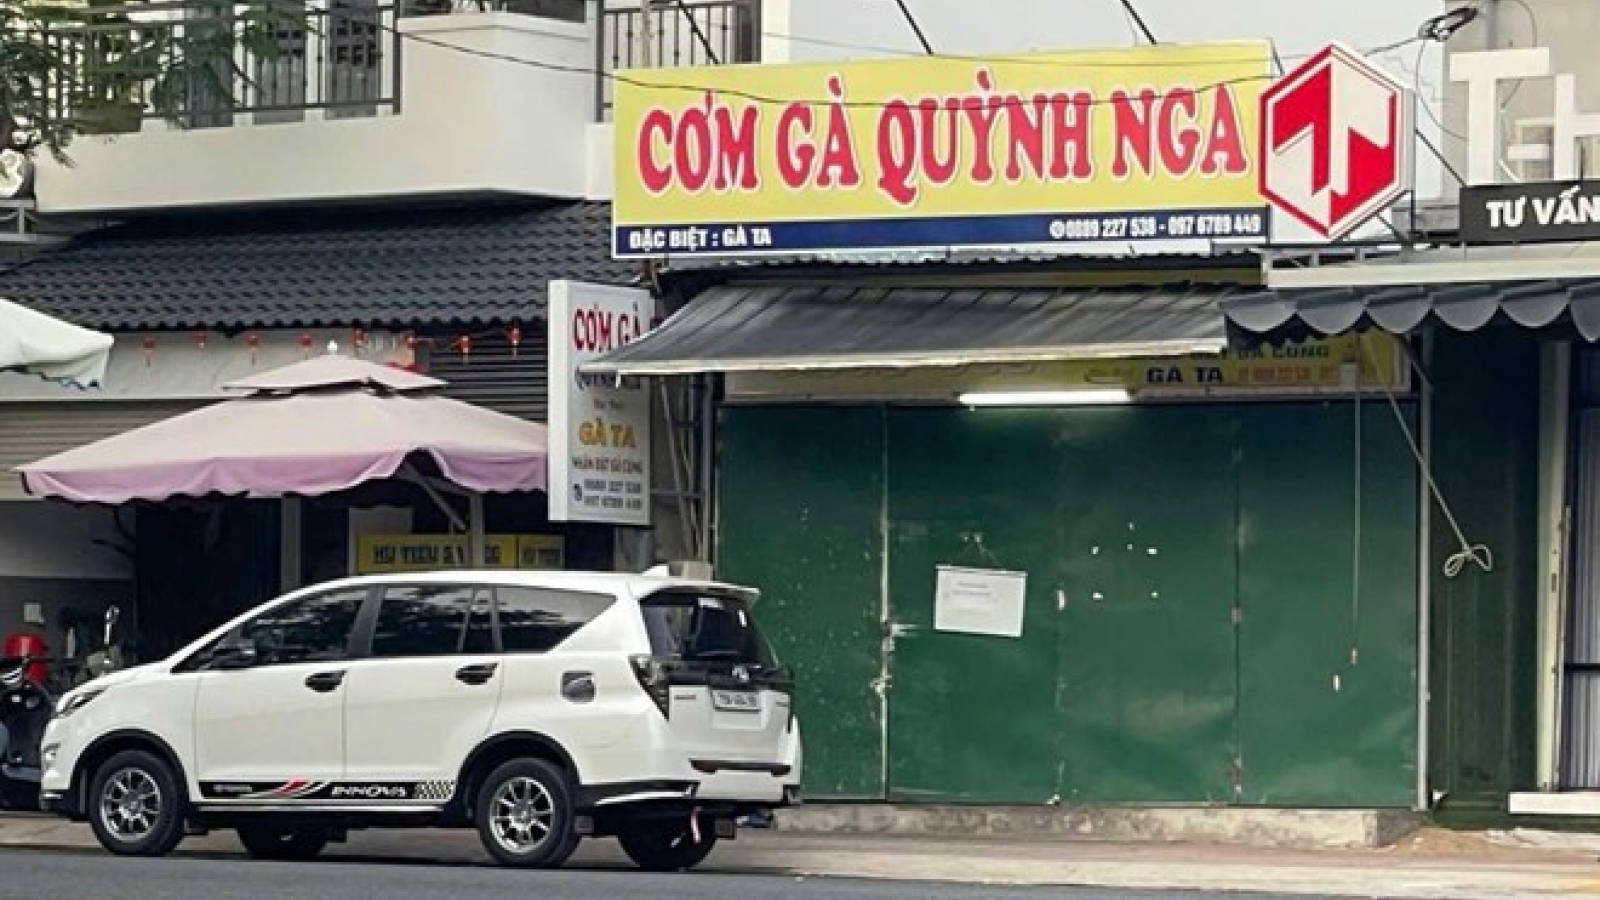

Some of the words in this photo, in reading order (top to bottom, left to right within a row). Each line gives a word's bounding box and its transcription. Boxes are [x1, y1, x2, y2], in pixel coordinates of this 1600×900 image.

[637, 89, 760, 194] CƠM
[776, 77, 858, 191] GÀ
[877, 70, 1094, 206] QUỲNH
[1112, 82, 1248, 178] NGA
[1486, 196, 1527, 228] TƯ
[1532, 185, 1600, 225] VẤN
[629, 228, 665, 251] ĐẶC
[669, 226, 708, 251] BIỆT
[722, 225, 747, 247] GÀ
[751, 228, 772, 247] TA
[573, 301, 612, 353] CƠM
[578, 417, 607, 447] GÀ
[610, 424, 636, 449] TA
[331, 785, 408, 798] INNOVA
